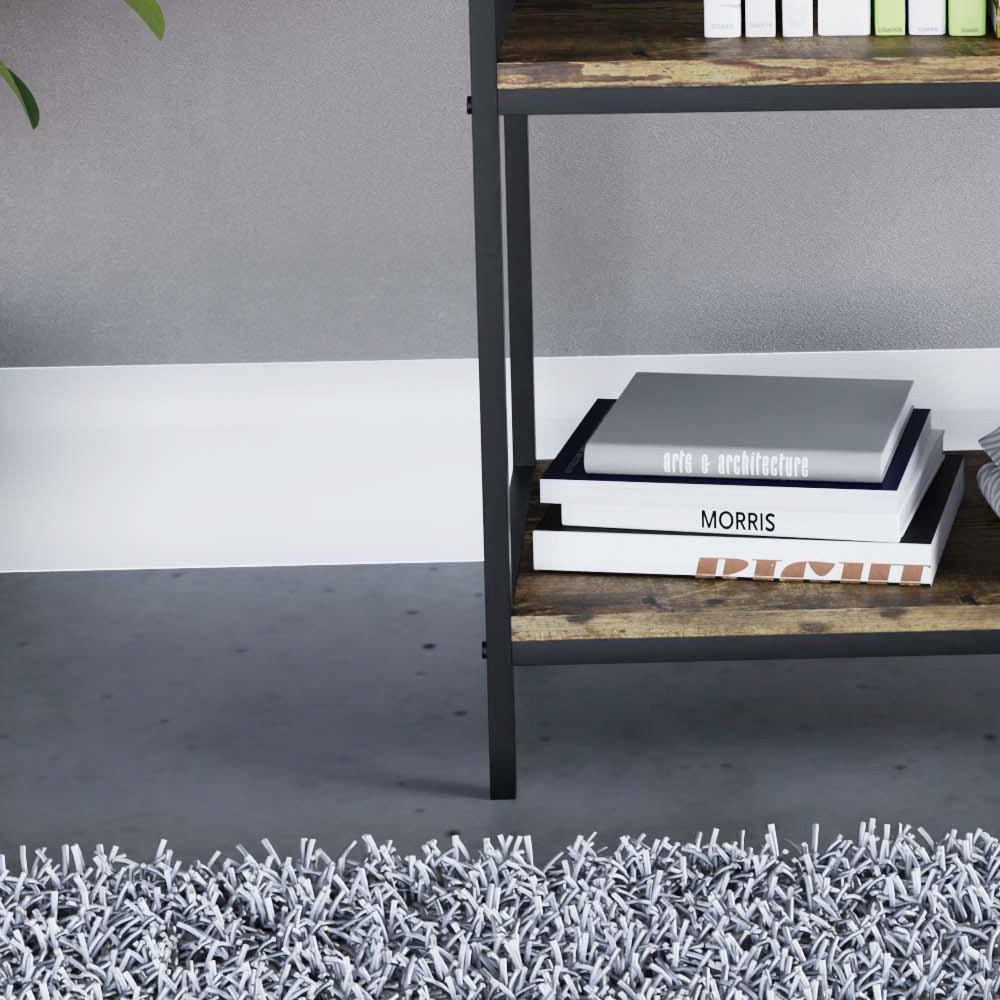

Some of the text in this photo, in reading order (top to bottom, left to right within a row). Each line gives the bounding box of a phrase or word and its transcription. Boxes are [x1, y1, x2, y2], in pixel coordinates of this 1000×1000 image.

[663, 450, 692, 474] arts
[718, 450, 809, 478] architecture
[701, 509, 775, 532] MORRIS
